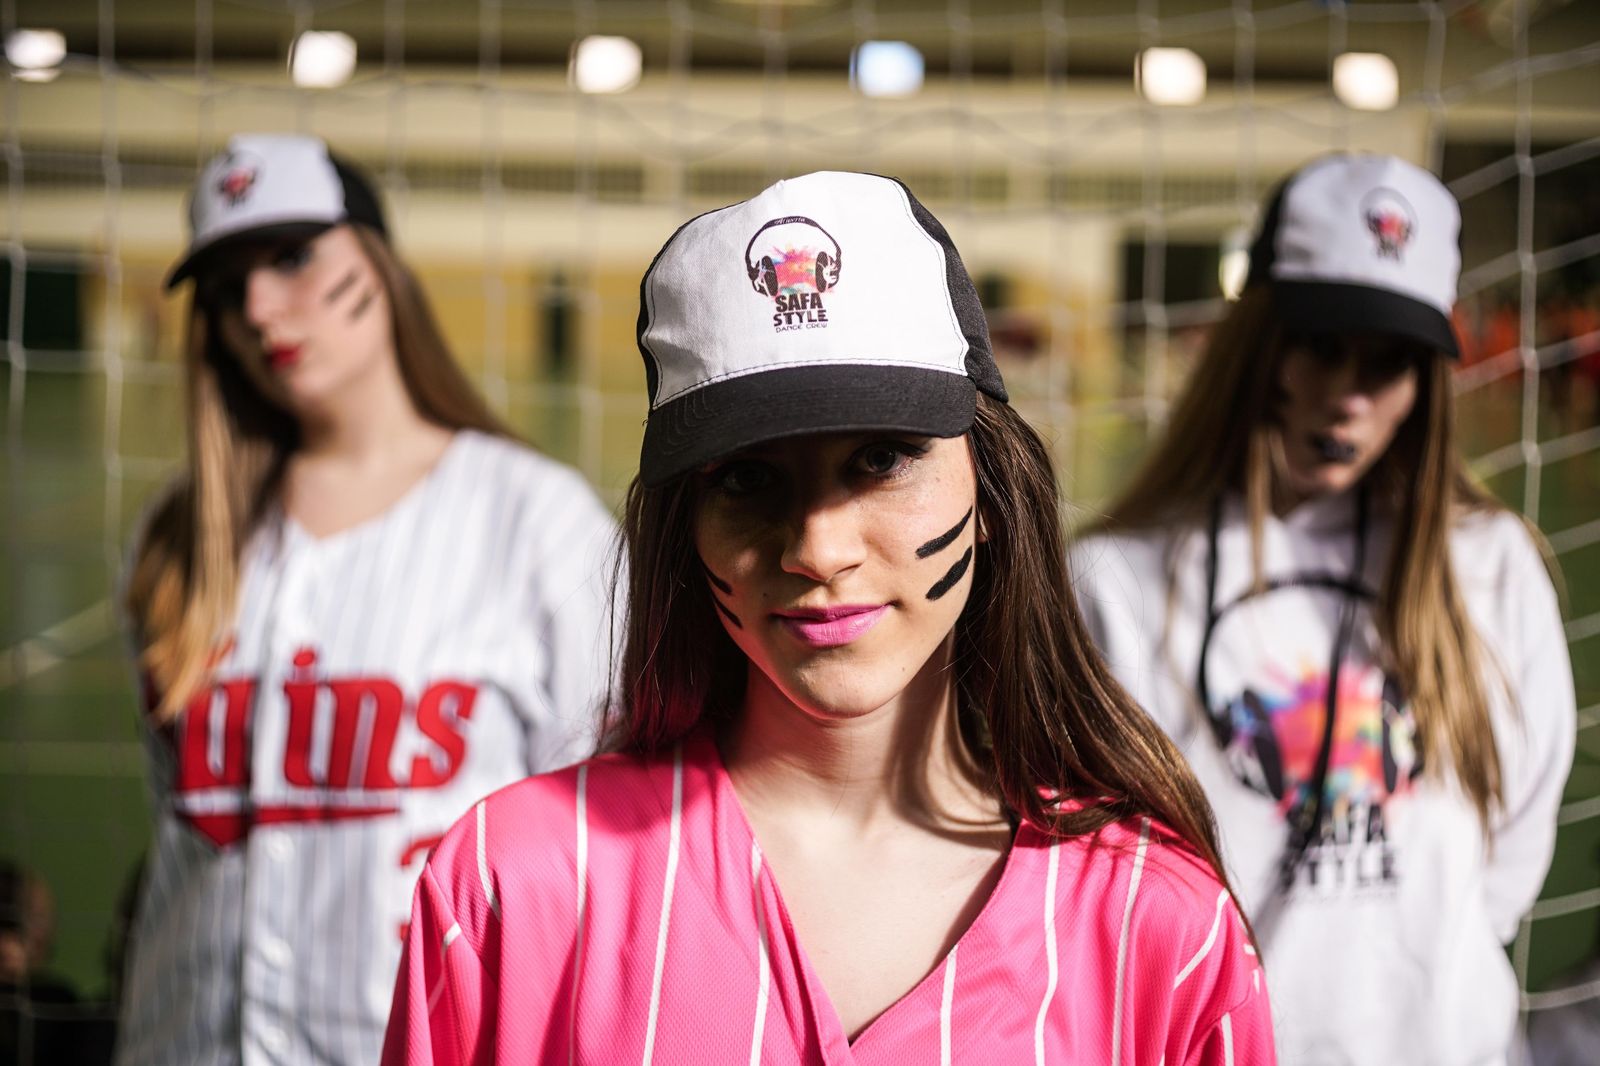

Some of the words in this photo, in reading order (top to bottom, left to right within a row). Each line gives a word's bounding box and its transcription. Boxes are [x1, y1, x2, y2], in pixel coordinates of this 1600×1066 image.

[775, 293, 823, 312] SAFA
[773, 310, 828, 326] STYLE
[775, 325, 802, 333] DANCE
